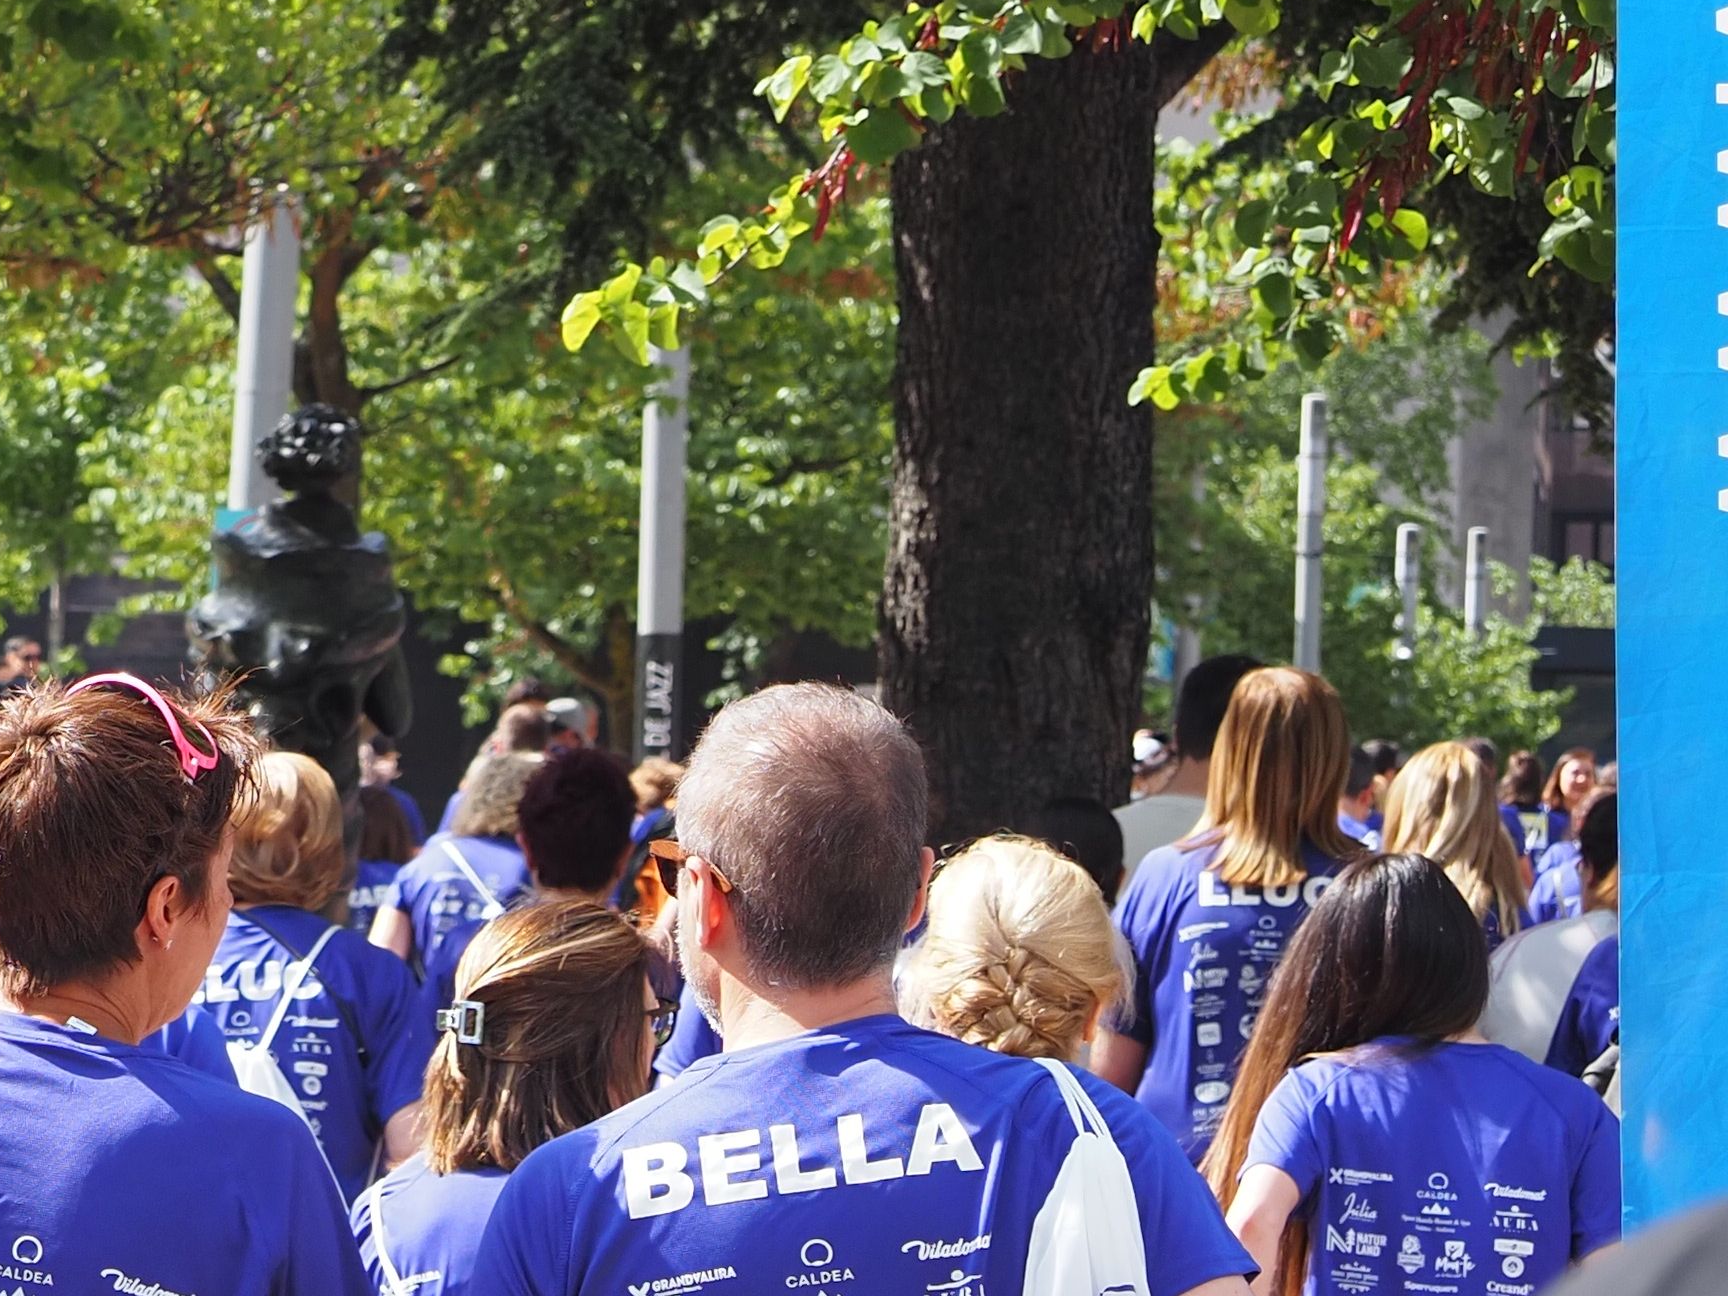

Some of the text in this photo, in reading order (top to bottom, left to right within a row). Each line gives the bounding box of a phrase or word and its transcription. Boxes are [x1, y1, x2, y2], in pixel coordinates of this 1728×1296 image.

[622, 1102, 985, 1220] BELLA
[1416, 1190, 1458, 1201] CALDEA
[1489, 1216, 1539, 1232] AURA
[1356, 1230, 1387, 1246] NATUR
[1356, 1242, 1381, 1257] LAND
[652, 1266, 737, 1294] GRANDVALIRA
[784, 1267, 855, 1289] CALDEA
